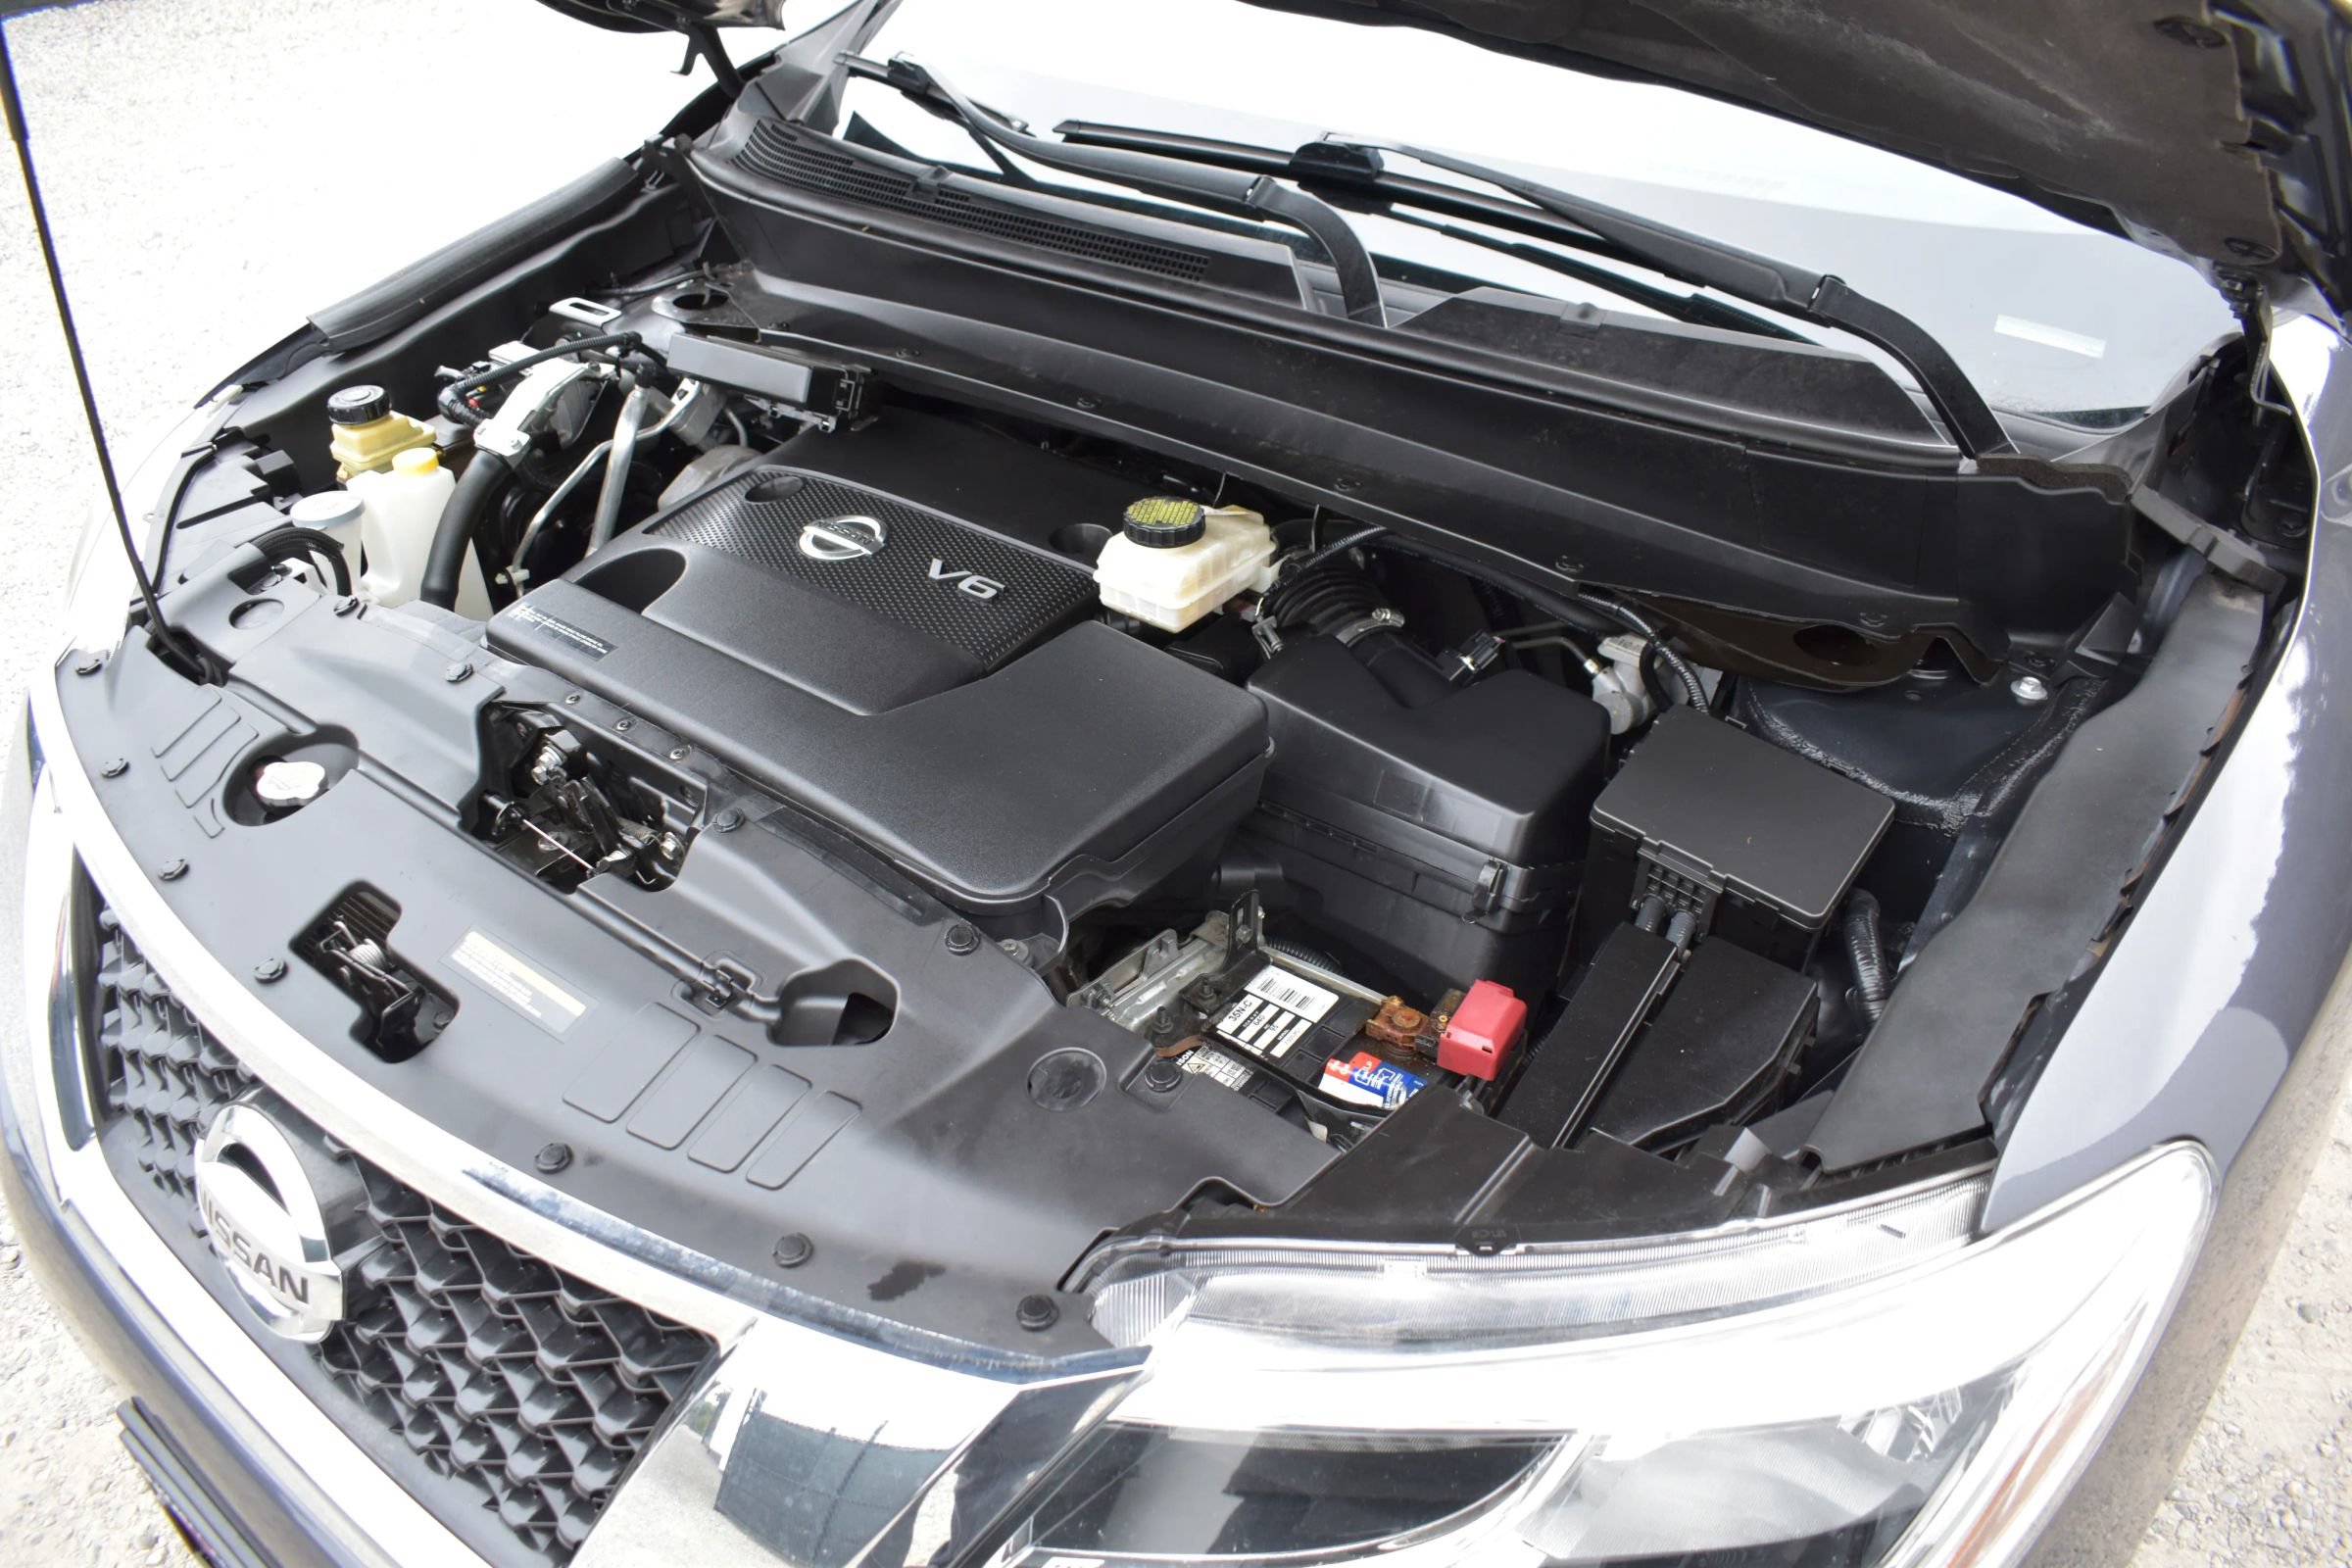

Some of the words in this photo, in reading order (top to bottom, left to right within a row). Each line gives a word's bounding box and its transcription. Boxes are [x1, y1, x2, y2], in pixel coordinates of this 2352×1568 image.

[817, 519, 874, 545] NISSAN
[928, 558, 1005, 599] V6
[1228, 1000, 1252, 1022] 35N-C
[1253, 1014, 1265, 1026] 640
[1176, 1050, 1195, 1066] ISON
